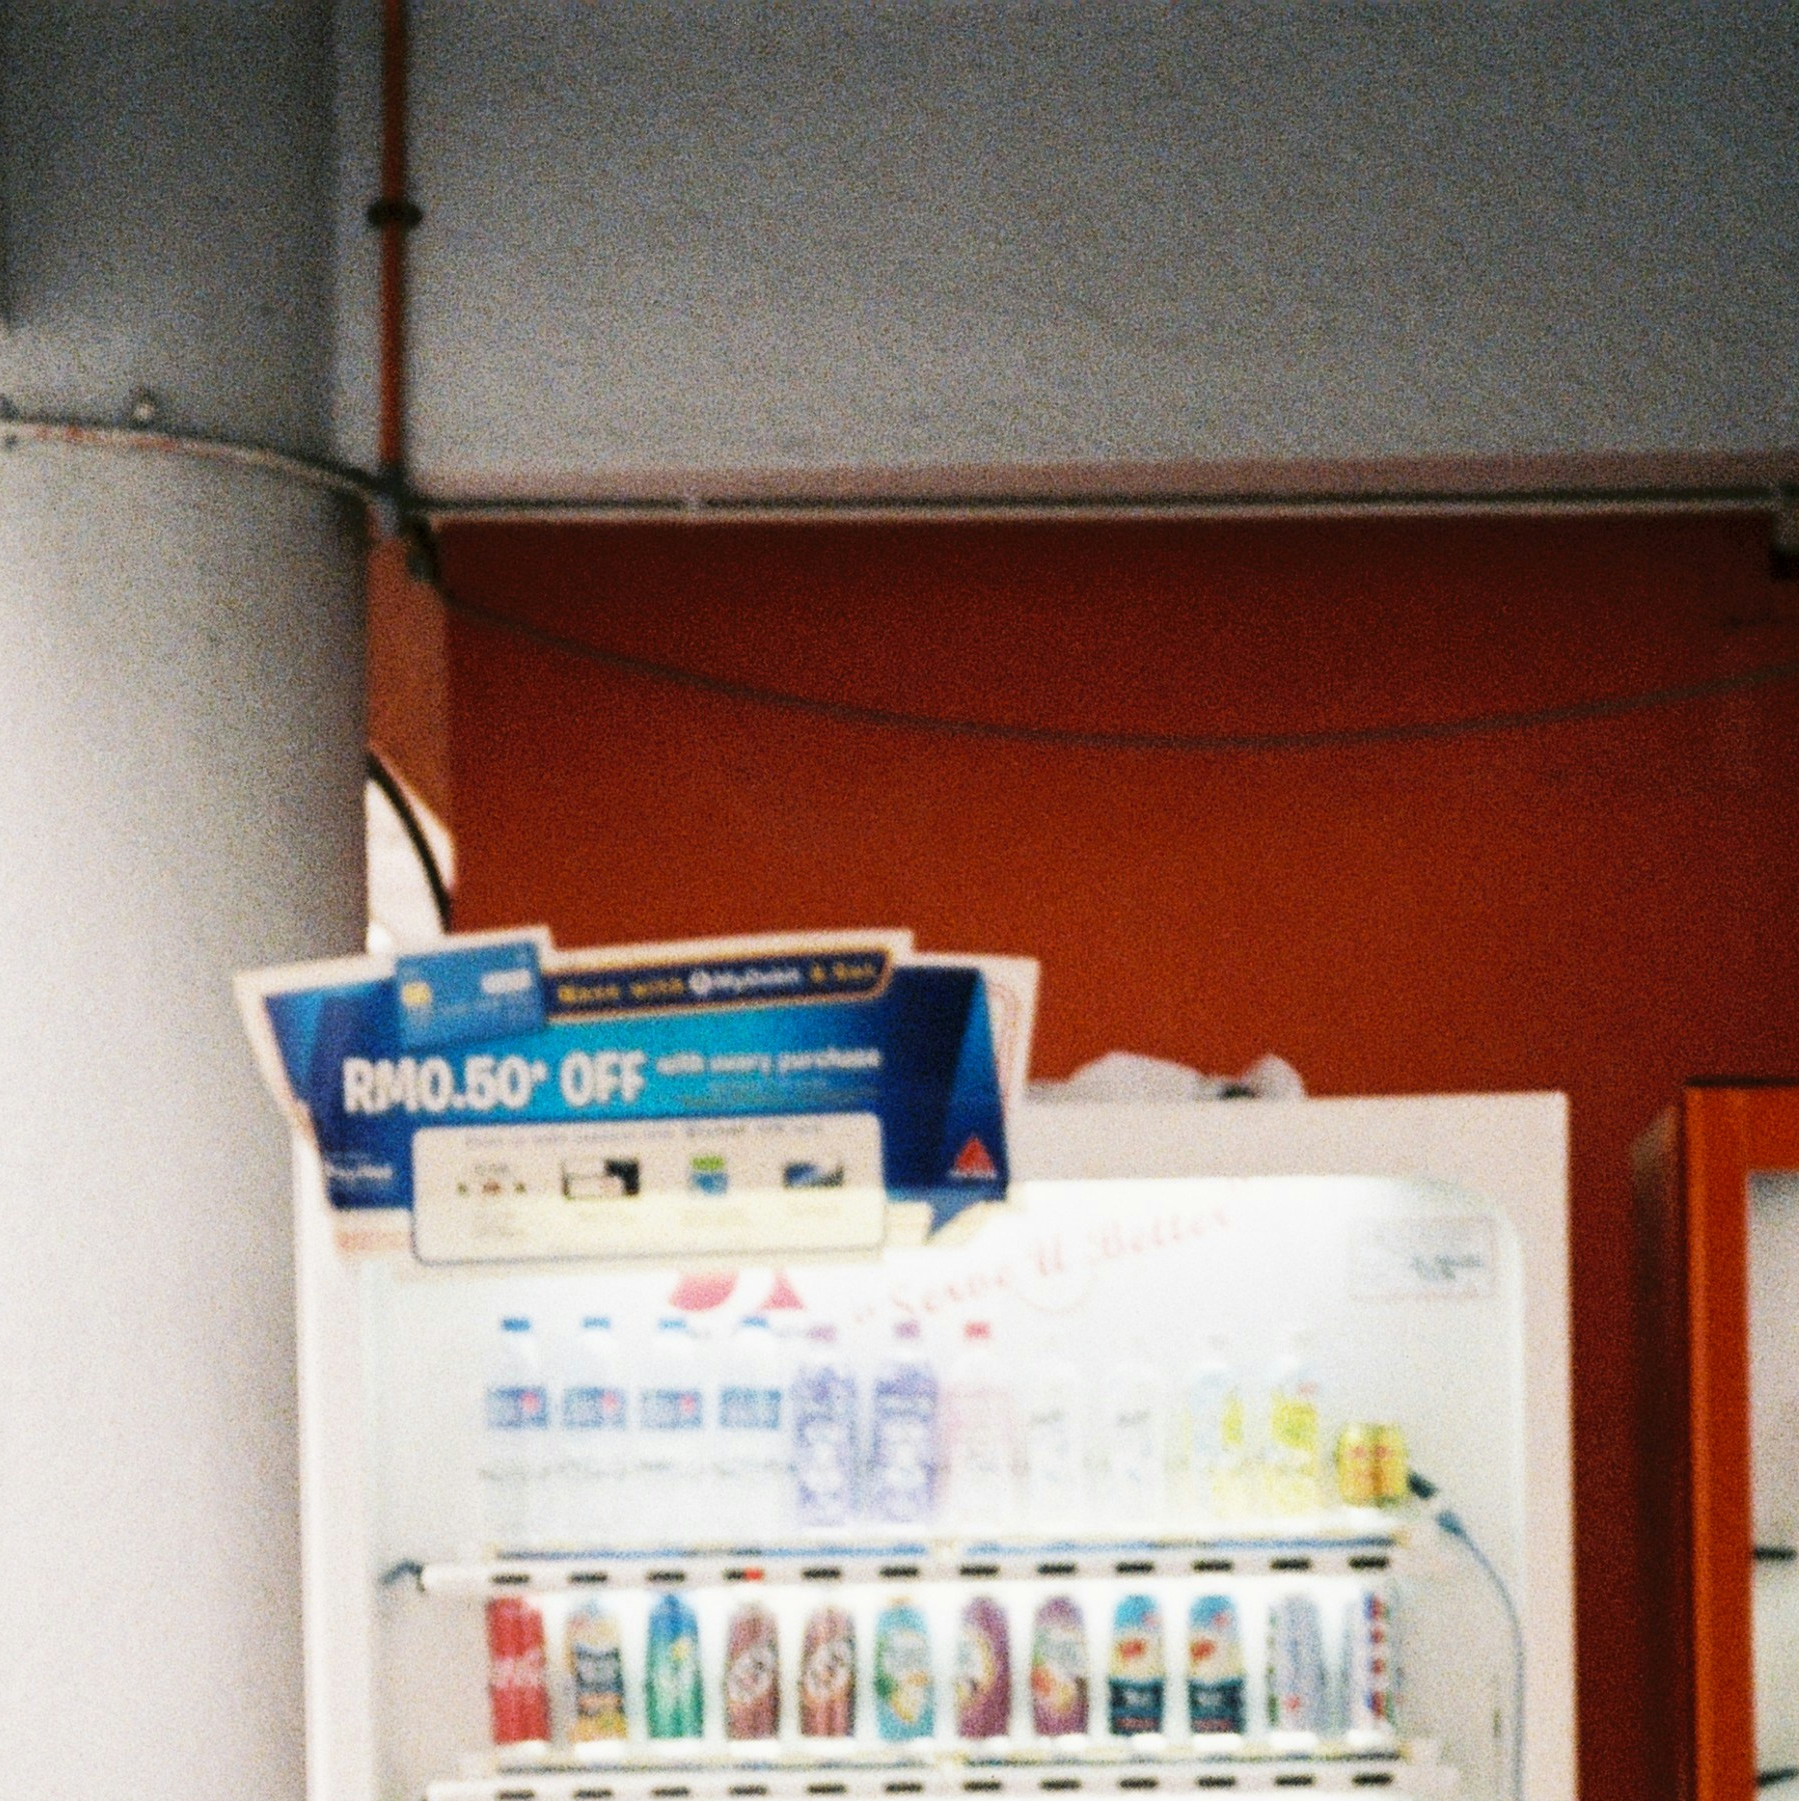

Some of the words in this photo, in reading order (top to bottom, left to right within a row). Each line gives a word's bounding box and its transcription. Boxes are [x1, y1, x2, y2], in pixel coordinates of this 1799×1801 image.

[559, 1049, 647, 1107] OFF
[655, 1050, 704, 1075] with
[709, 1053, 772, 1076] every
[777, 1045, 882, 1077] purchase
